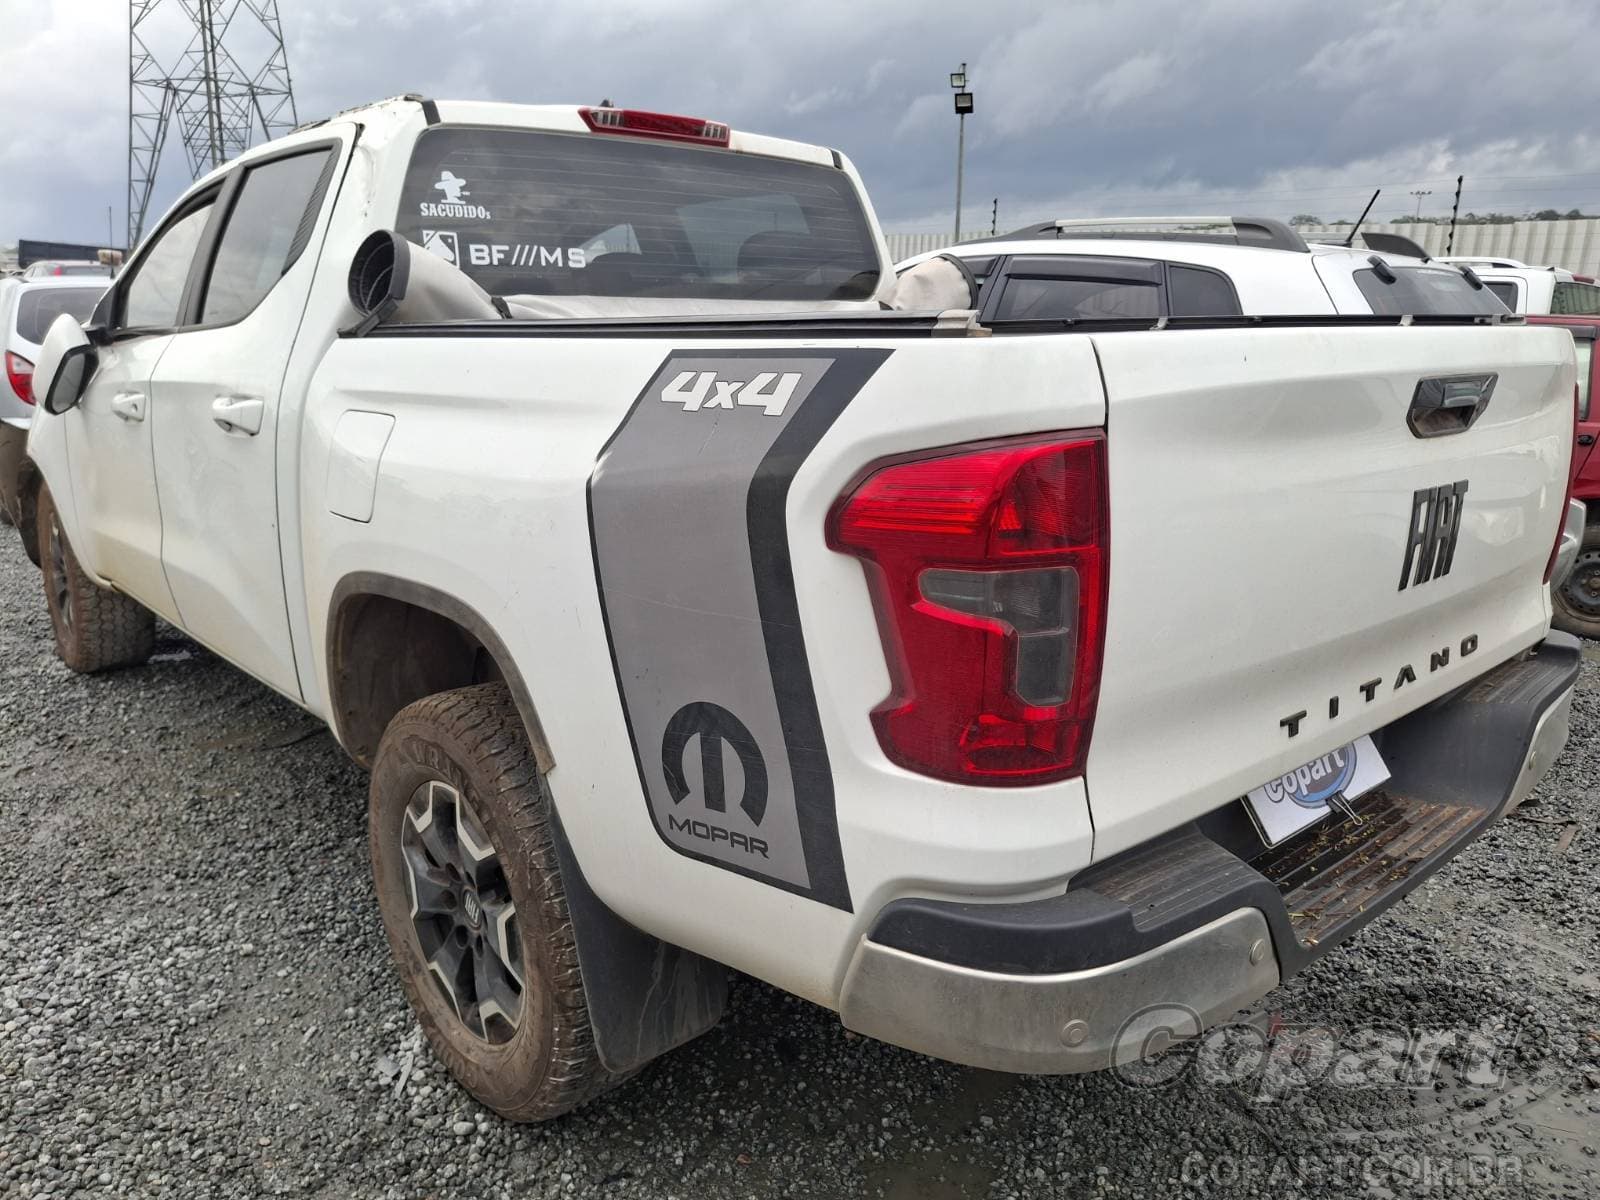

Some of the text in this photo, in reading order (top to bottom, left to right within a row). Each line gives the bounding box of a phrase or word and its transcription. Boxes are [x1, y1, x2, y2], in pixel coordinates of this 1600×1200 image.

[660, 371, 803, 417] 4x4
[1398, 479, 1469, 592] FIAT
[1280, 633, 1479, 738] TITANO
[668, 813, 769, 859] MOPAR
